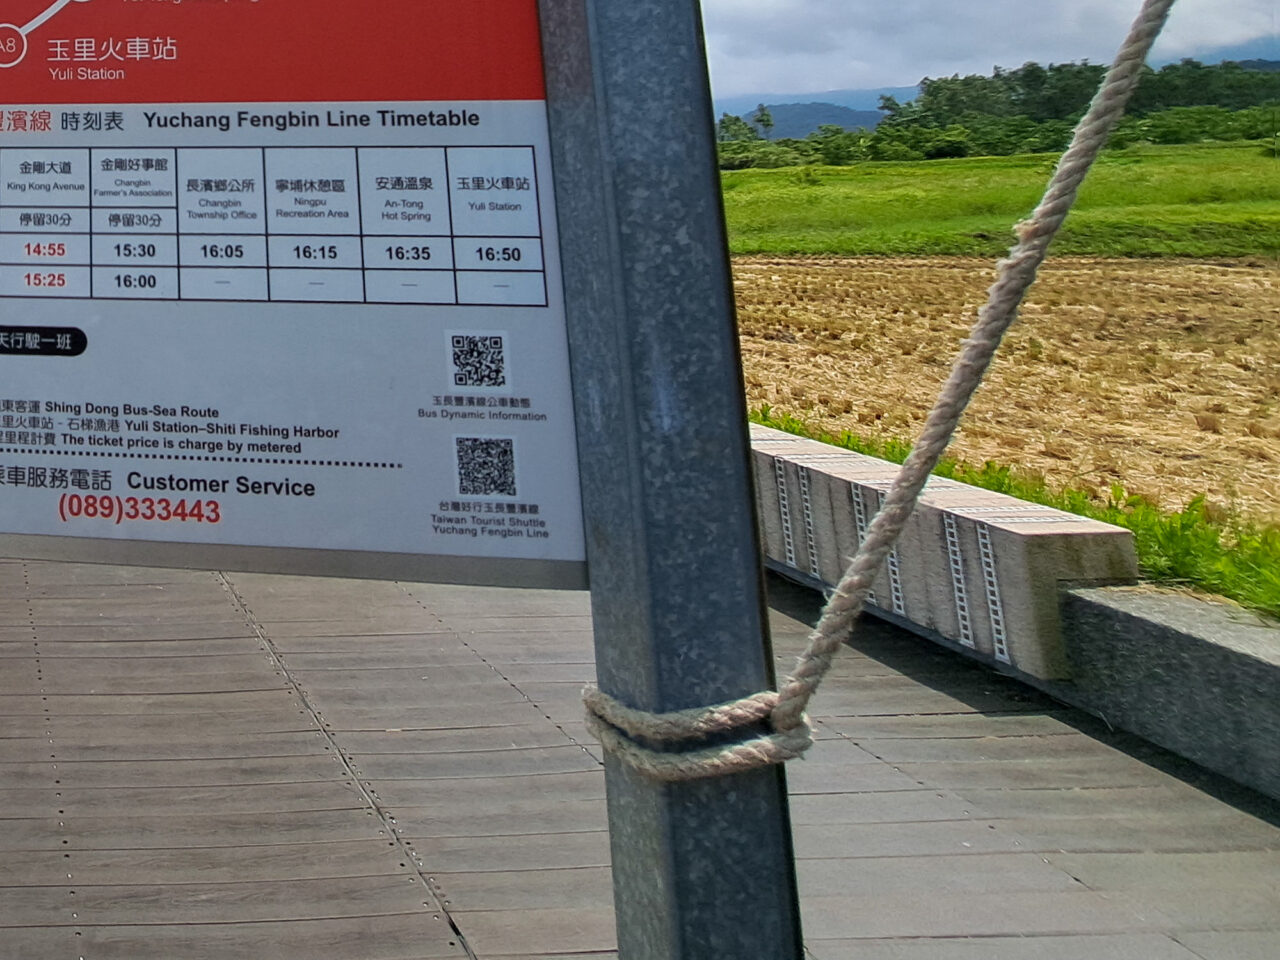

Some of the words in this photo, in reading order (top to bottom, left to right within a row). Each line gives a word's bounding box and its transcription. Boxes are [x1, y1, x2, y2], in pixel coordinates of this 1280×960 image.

[47, 37, 177, 62] 玉里火車站
[49, 68, 73, 80] Yuli
[77, 67, 124, 80] Station
[61, 111, 124, 131] 時刻表
[144, 111, 230, 132] Yuchang
[237, 110, 320, 131] Fengbin
[327, 110, 370, 127] Line
[377, 110, 479, 127] Timetable
[20, 161, 72, 174] 金剛大道
[101, 158, 168, 172] 金剛好事館
[7, 182, 27, 192] King
[28, 182, 50, 192] Kong
[114, 179, 151, 187] Changbin
[187, 179, 255, 193] 長濱鄉公所
[375, 176, 433, 191] 安通溫泉
[457, 176, 530, 191] 玉里火車站
[129, 189, 172, 197] Association
[199, 198, 241, 208] Changbin
[294, 197, 326, 207] Ningpu
[385, 199, 424, 209] An-Tong
[468, 202, 486, 210] Yuli
[488, 202, 522, 211] Station
[20, 213, 72, 227] 停留30分
[109, 213, 162, 227] 停留30分
[187, 210, 228, 220] Township
[231, 210, 257, 219] Office
[276, 209, 324, 218] Recreation
[327, 209, 349, 218] Area
[382, 212, 398, 220] Hot
[401, 211, 431, 221] Spring
[24, 243, 65, 256] 14:55
[114, 244, 156, 257] 15:30
[201, 244, 244, 258] 16:05
[294, 246, 337, 259] 16:15
[386, 247, 431, 260] 16:35
[476, 247, 521, 261] 16:50
[24, 273, 65, 287] 15:25
[115, 275, 156, 288] 16:00
[45, 401, 81, 416] Shing
[85, 403, 119, 417] Dong
[123, 404, 176, 417] Bus-Sea
[180, 406, 219, 418] Route
[418, 408, 437, 418] Bus
[441, 409, 485, 421] Dynamic
[489, 411, 547, 421] Information
[125, 420, 148, 432] Yuli
[240, 424, 289, 439] Fishing
[293, 426, 339, 438] Harbor
[61, 434, 85, 445] The
[88, 435, 123, 447] ticket
[127, 437, 159, 450] price
[163, 438, 174, 449] is
[178, 439, 223, 453] charge
[227, 440, 243, 454] by
[247, 441, 302, 454] metered
[127, 471, 229, 493] Customer
[235, 476, 316, 497] Service
[58, 493, 220, 525] (089)333443
[431, 514, 467, 524] Taiwan
[471, 516, 505, 526] Tourist
[509, 517, 546, 528] Shuttle
[432, 525, 477, 537] Yuchang
[481, 527, 523, 538] Fengbin
[527, 529, 549, 538] Line
